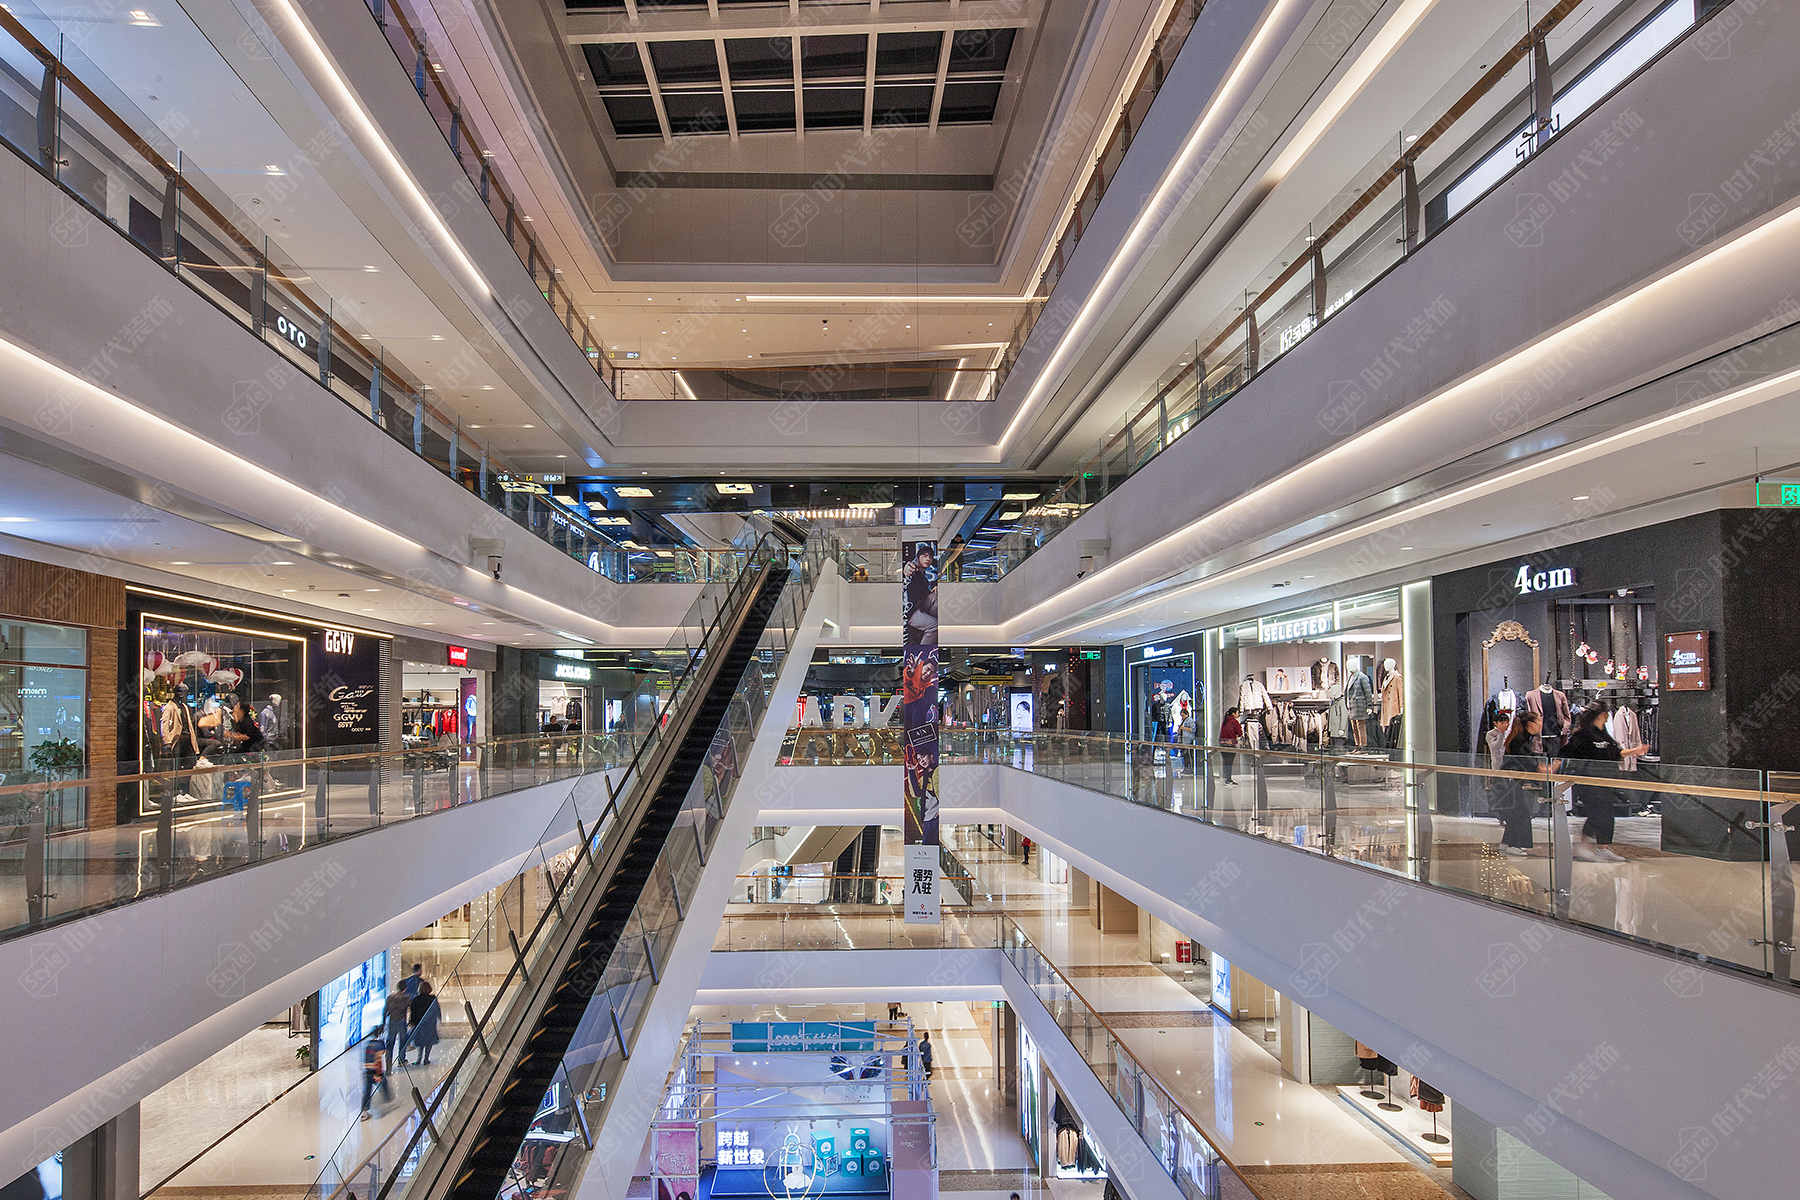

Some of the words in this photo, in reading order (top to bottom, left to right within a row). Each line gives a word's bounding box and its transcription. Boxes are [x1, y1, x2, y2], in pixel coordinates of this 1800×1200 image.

[277, 315, 307, 349] OTO
[1514, 565, 1575, 595] 4cm
[1264, 617, 1329, 643] SELECTED
[1672, 649, 1697, 661] 4cm
[913, 869, 933, 881] 强势
[912, 882, 932, 894] 入驻
[718, 1131, 749, 1147] 跨越
[718, 1149, 766, 1166] 新世象
